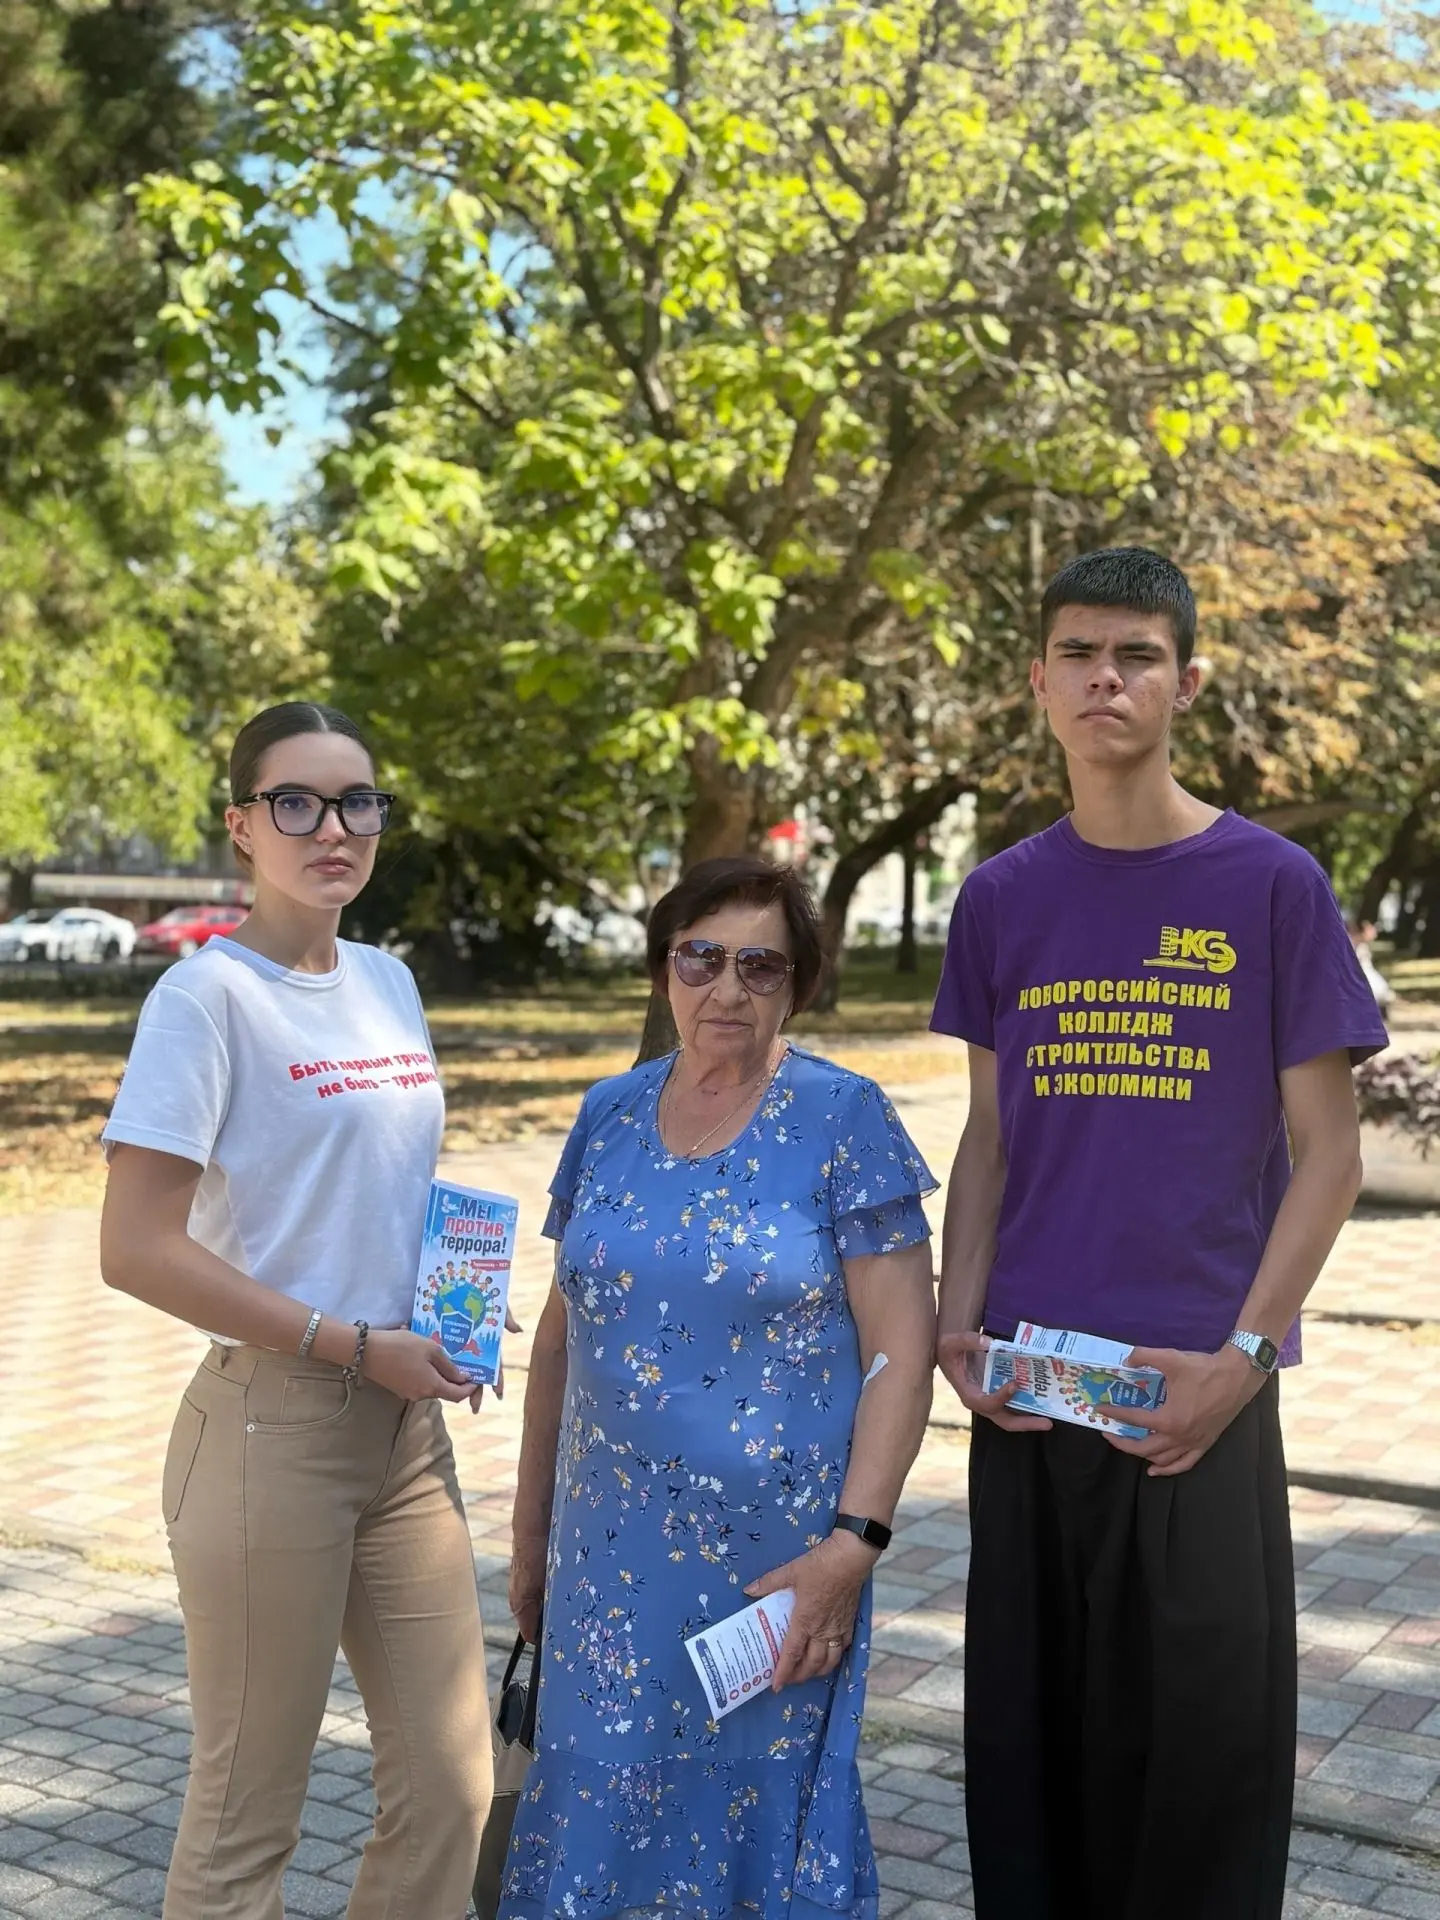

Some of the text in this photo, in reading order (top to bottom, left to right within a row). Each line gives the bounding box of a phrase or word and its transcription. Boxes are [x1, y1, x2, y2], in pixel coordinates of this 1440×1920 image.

[1018, 976, 1232, 1011] НОВОРОССИЙСКИЙ
[1058, 1010, 1174, 1037] КОЛЛЕДЖ
[1026, 1041, 1211, 1071] СТРОИТЕЛЬСТВА
[288, 1060, 338, 1081] Быть
[337, 1057, 393, 1074] первым
[317, 1081, 344, 1099] не
[344, 1076, 379, 1091] быть
[1034, 1072, 1192, 1101] И ЭКОНОМИКИ
[460, 1198, 492, 1220] Мы
[446, 1216, 504, 1237] против
[441, 1235, 507, 1256] террора!
